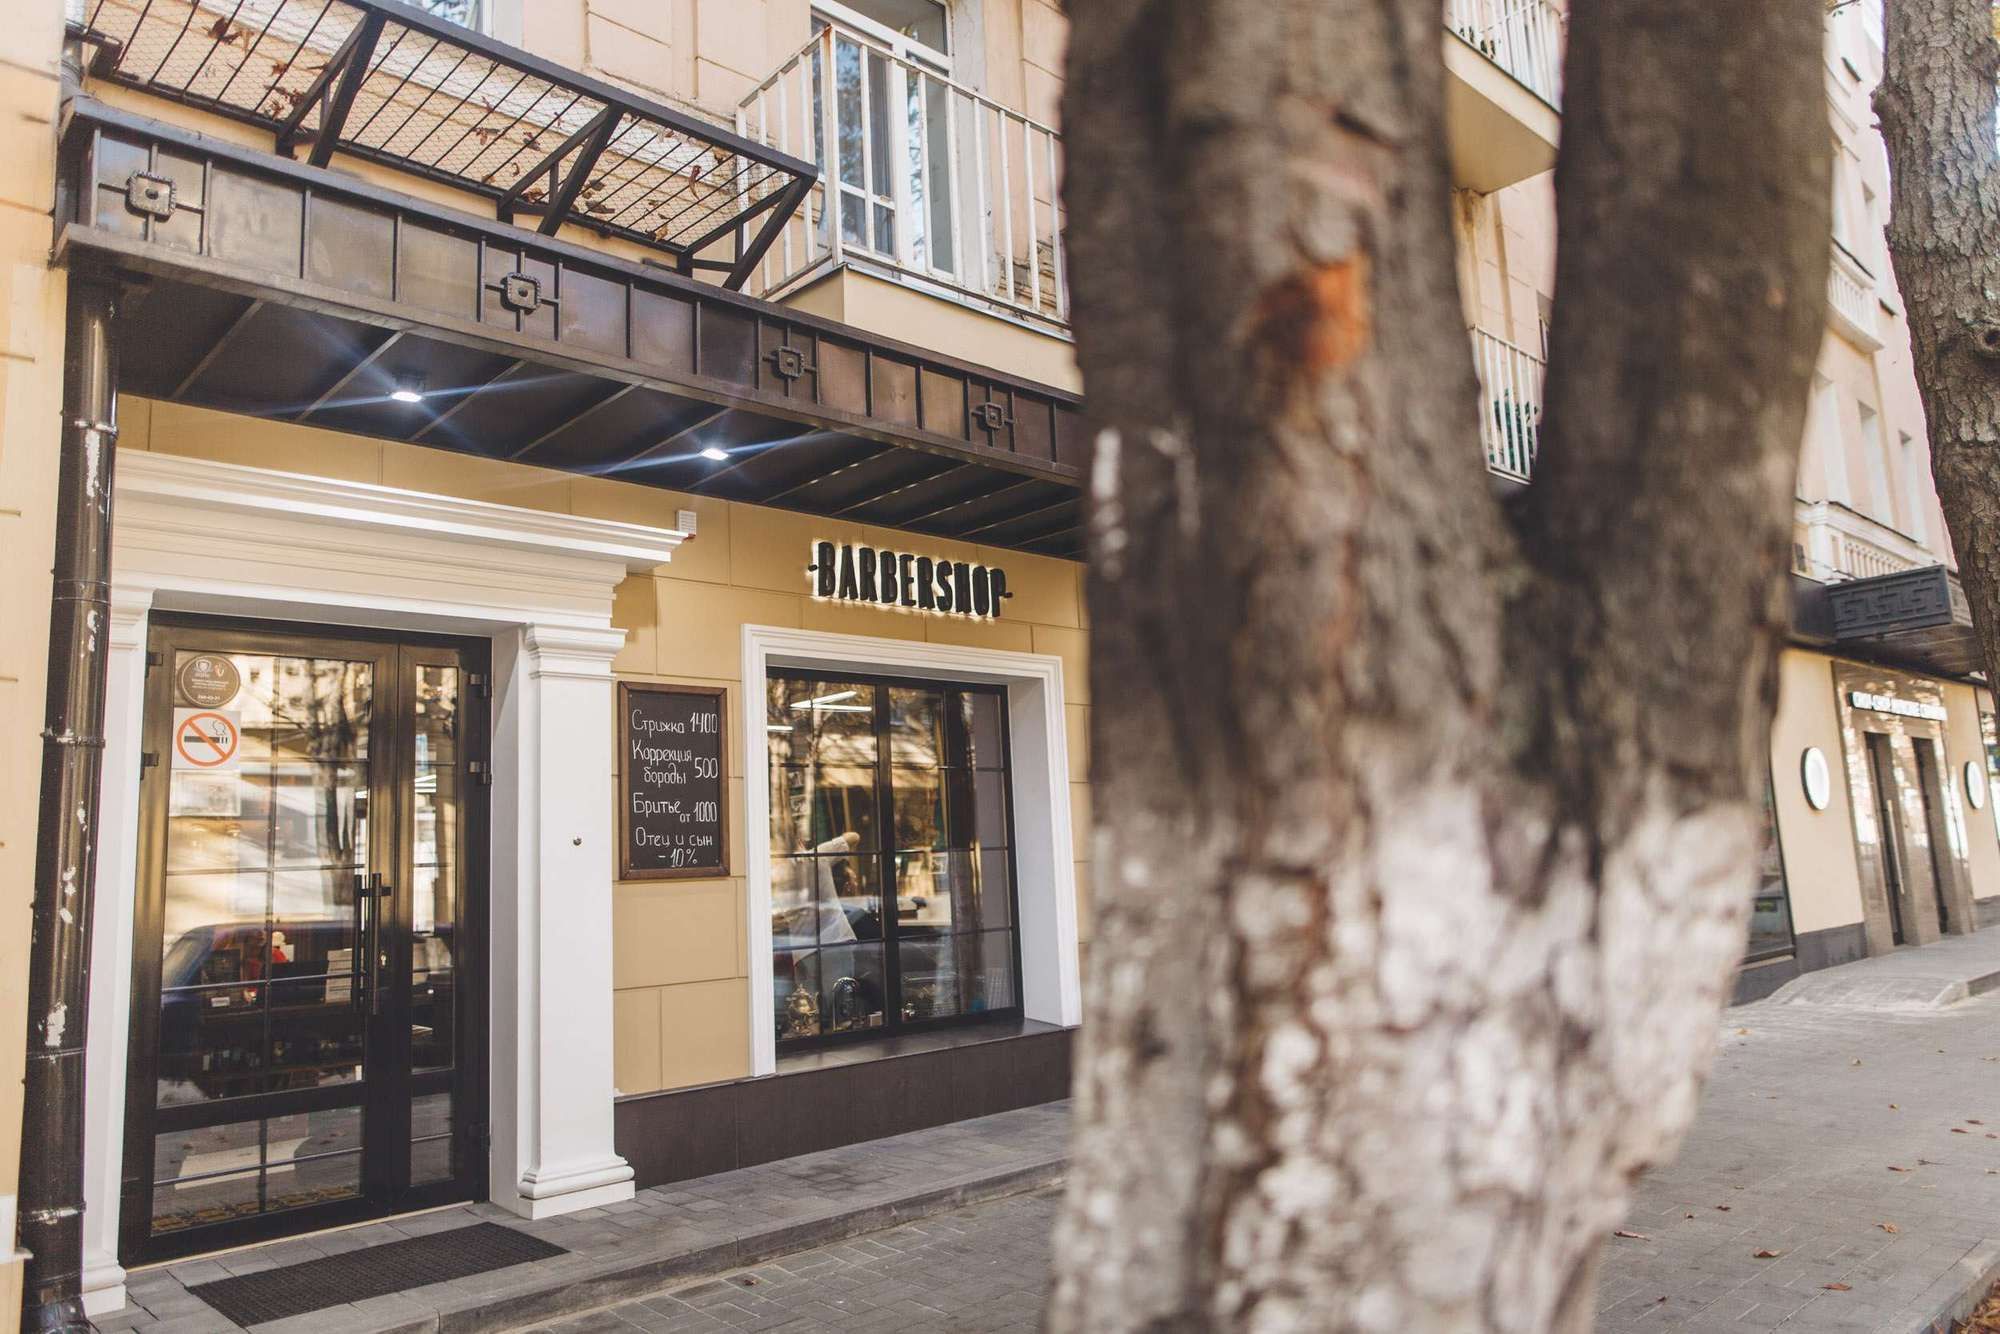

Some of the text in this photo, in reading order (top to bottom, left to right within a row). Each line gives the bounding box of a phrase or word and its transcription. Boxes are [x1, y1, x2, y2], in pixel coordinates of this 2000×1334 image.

[818, 541, 1007, 617] BARBERSHOP
[631, 709, 718, 737] Стрижка 1400
[632, 739, 719, 779] Коррекция 500
[643, 763, 687, 787] бороды
[632, 792, 718, 823] Бритье от 1000
[635, 826, 713, 847] Отец и сын
